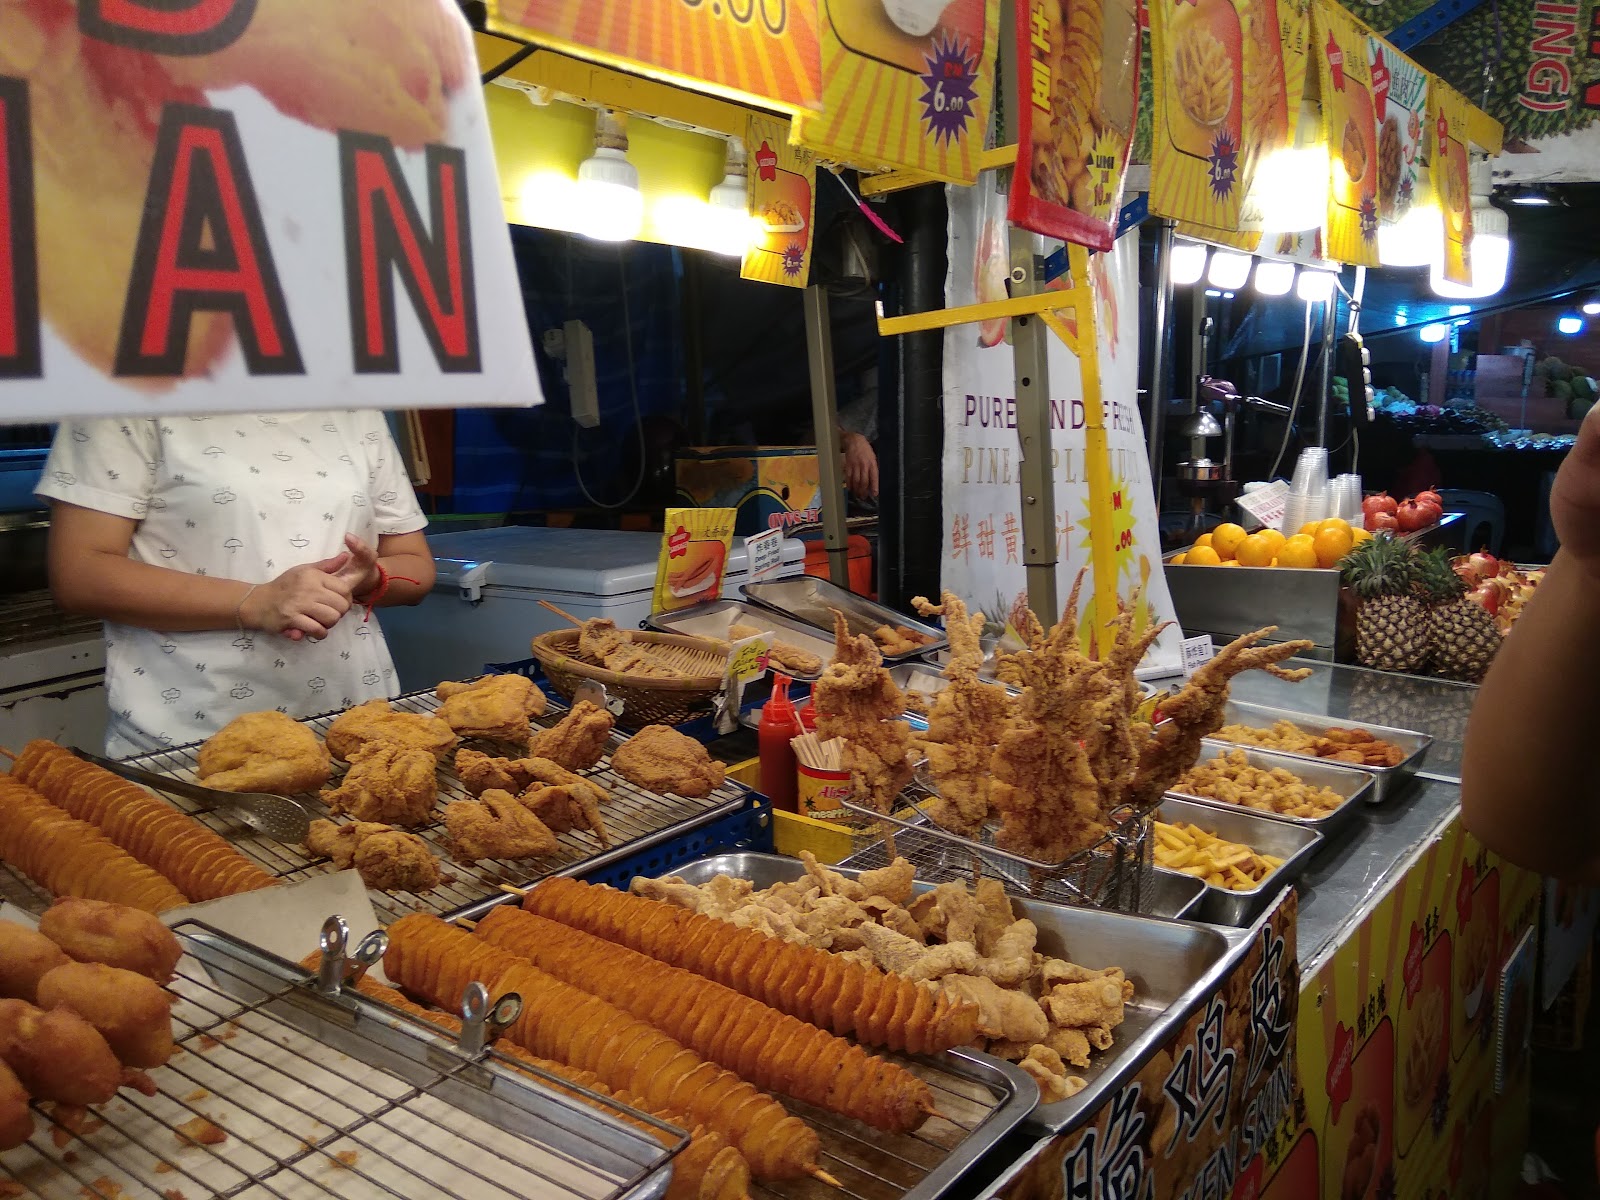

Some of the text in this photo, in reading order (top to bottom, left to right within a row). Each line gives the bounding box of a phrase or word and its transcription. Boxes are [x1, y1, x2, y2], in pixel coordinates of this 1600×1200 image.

[933, 80, 964, 113] 6.00
[0, 76, 482, 378] AN
[963, 394, 1017, 428] PURE
[1051, 399, 1085, 430] ND
[961, 446, 1090, 484] PINEPL
[951, 511, 1076, 567] 鲜甜黄汁
